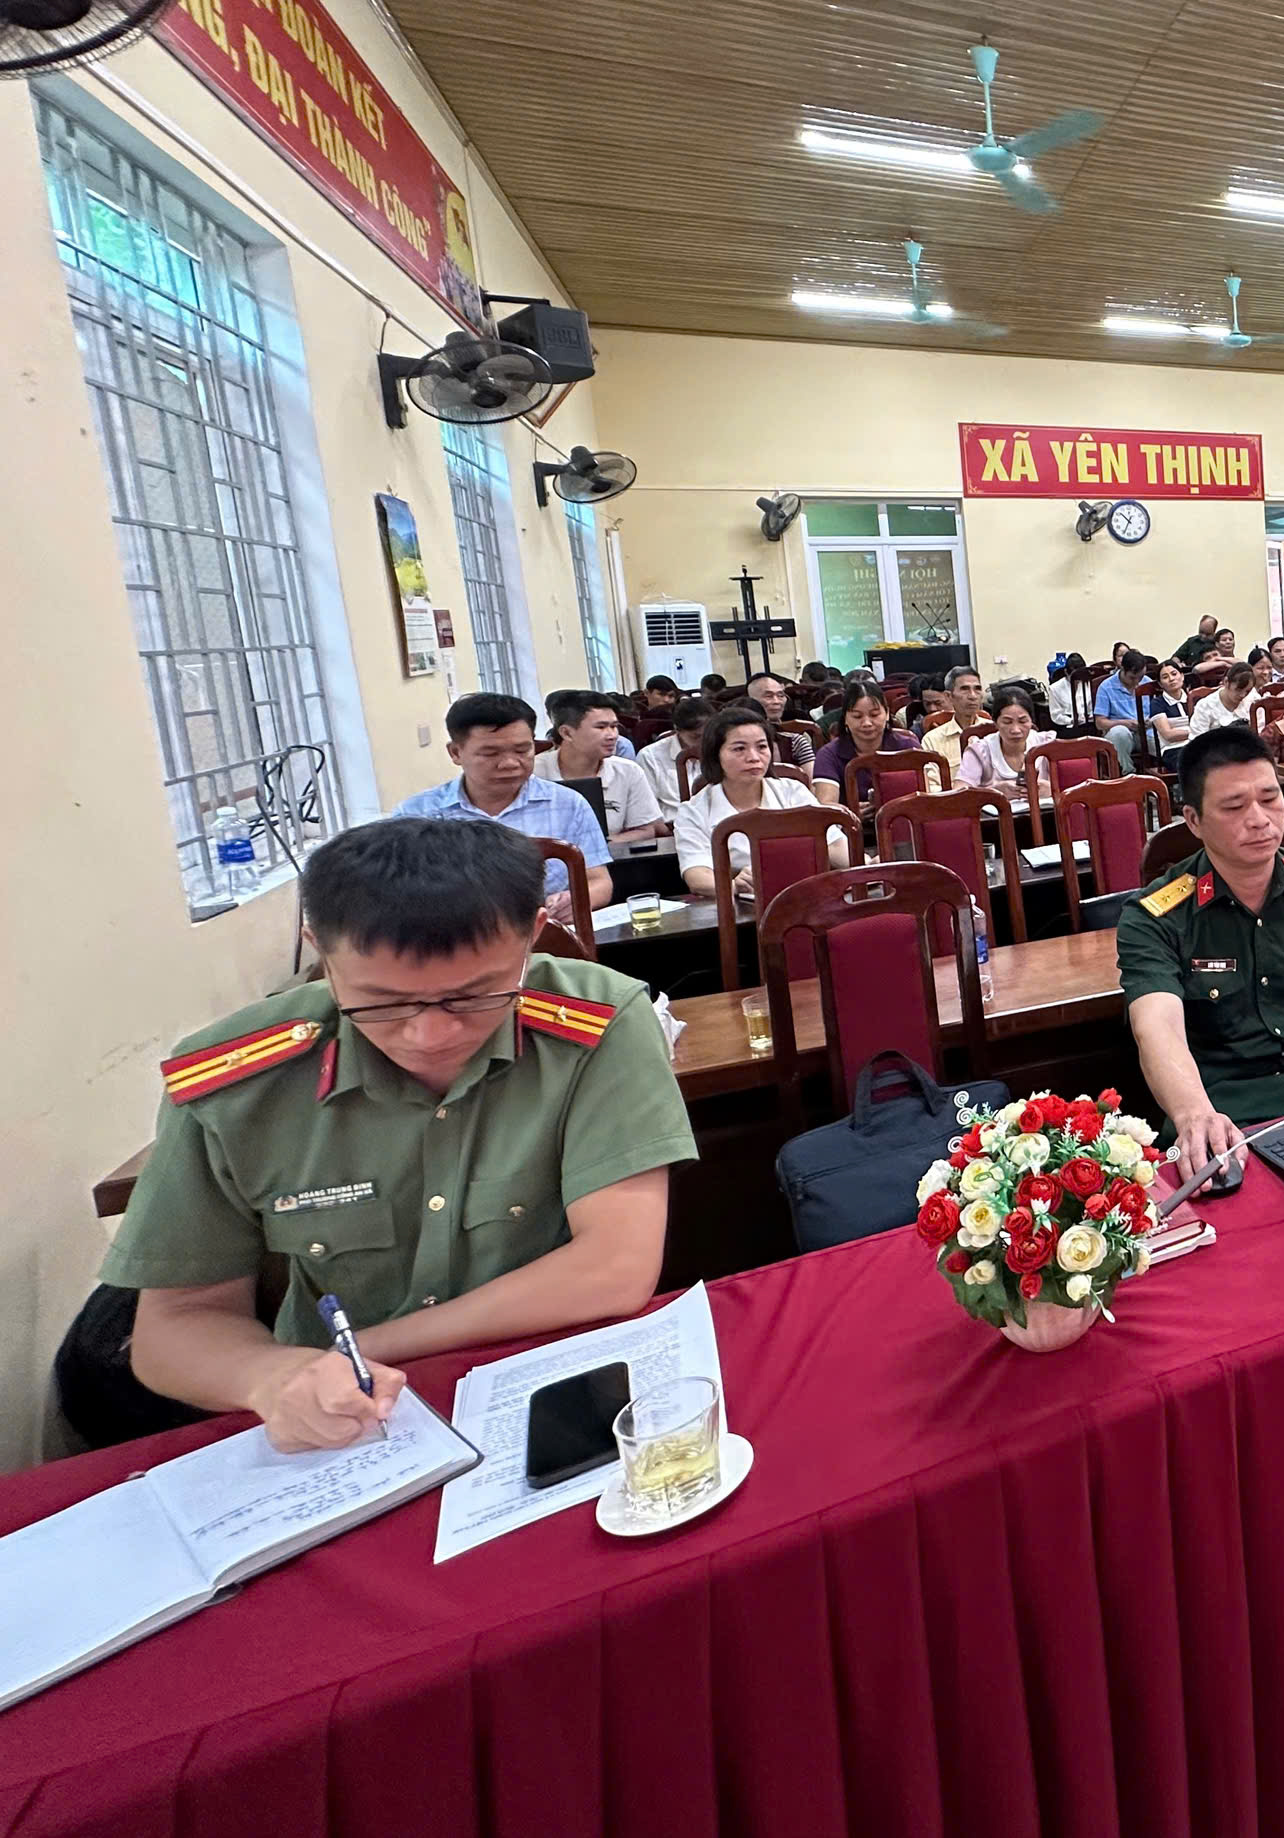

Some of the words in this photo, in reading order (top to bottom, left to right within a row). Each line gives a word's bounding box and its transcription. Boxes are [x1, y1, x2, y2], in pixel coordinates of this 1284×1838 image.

[243, 23, 299, 128] ĐẠI
[300, 88, 379, 210] THÀNH
[348, 70, 387, 151] KẾT
[978, 431, 1039, 482] XÃ
[1049, 432, 1129, 484] YÊN
[1139, 443, 1251, 494] THỊNH
